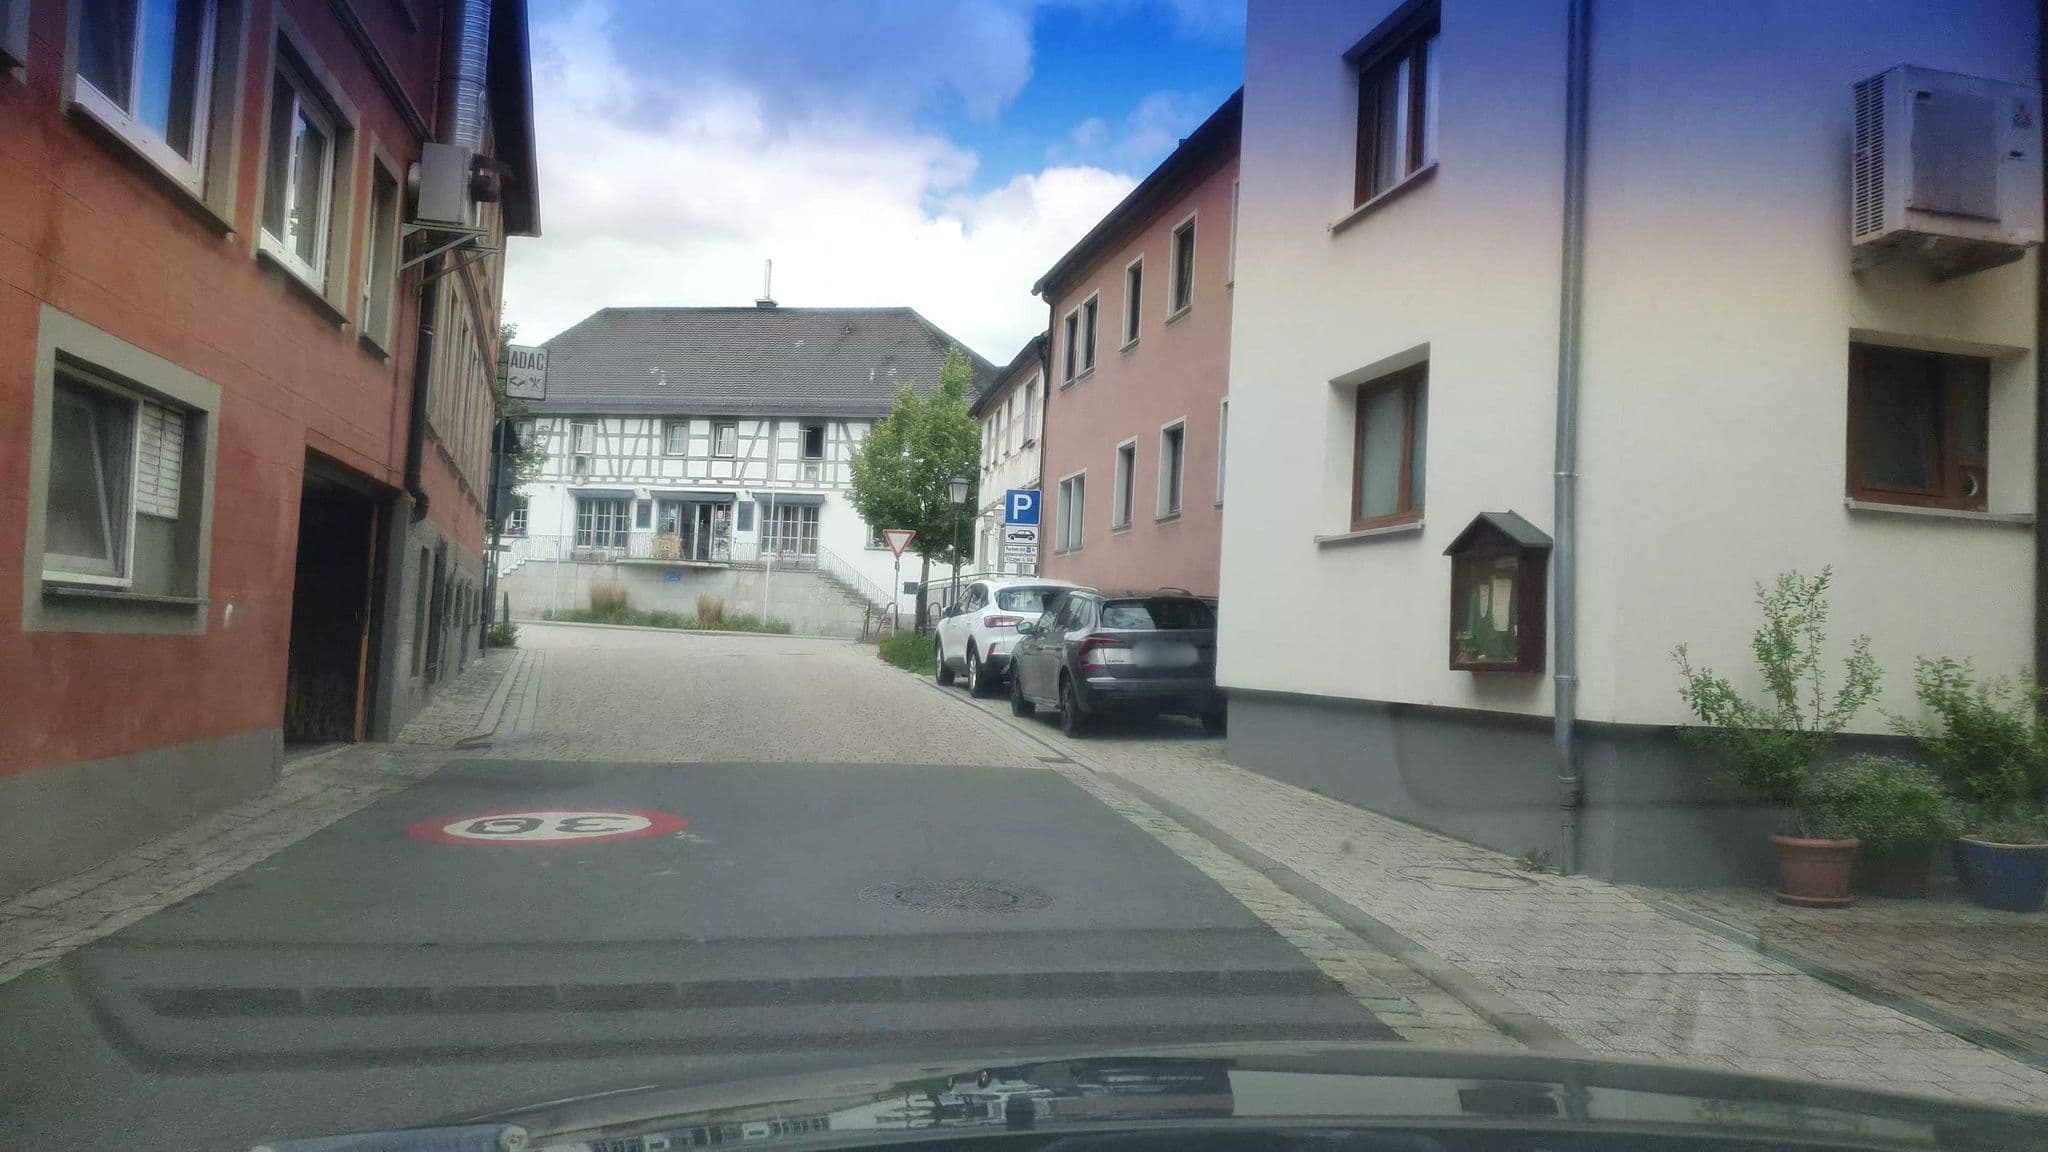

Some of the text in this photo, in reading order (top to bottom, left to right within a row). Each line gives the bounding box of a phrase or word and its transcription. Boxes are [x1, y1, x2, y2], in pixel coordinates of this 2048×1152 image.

[510, 351, 544, 370] ADAC
[1013, 494, 1032, 520] P
[465, 816, 632, 834] 30
